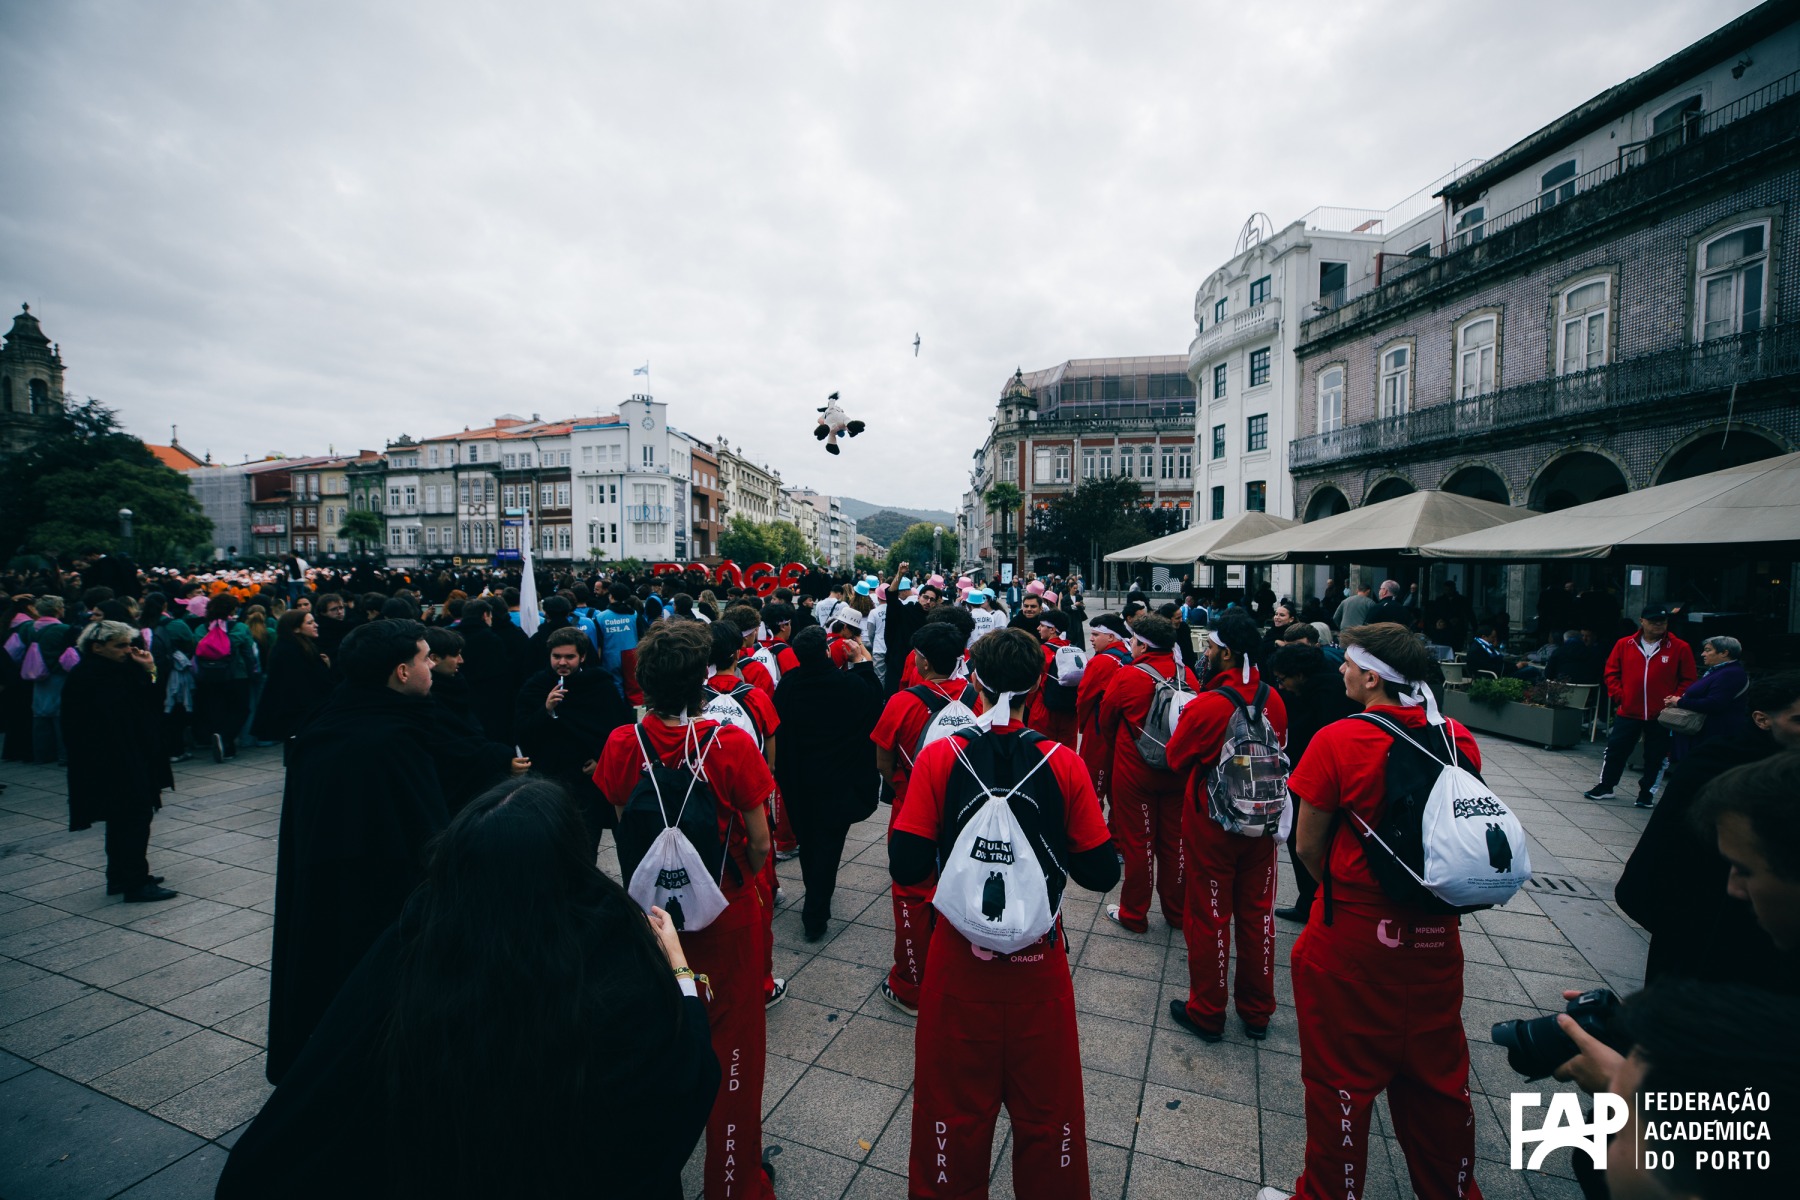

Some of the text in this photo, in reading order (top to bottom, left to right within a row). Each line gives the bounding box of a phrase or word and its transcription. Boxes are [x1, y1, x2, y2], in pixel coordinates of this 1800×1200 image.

[605, 625, 631, 633] ISLA
[1141, 803, 1151, 834] DVRA
[905, 938, 919, 987] PRAXI
[1210, 879, 1225, 988] DVRA PRAXIS
[1263, 915, 1271, 975] PRAXIS
[724, 1048, 740, 1198] SED PRAXI
[1060, 1122, 1071, 1168] SED
[1338, 1089, 1353, 1147] DVRA
[935, 1121, 948, 1184] DVRA
